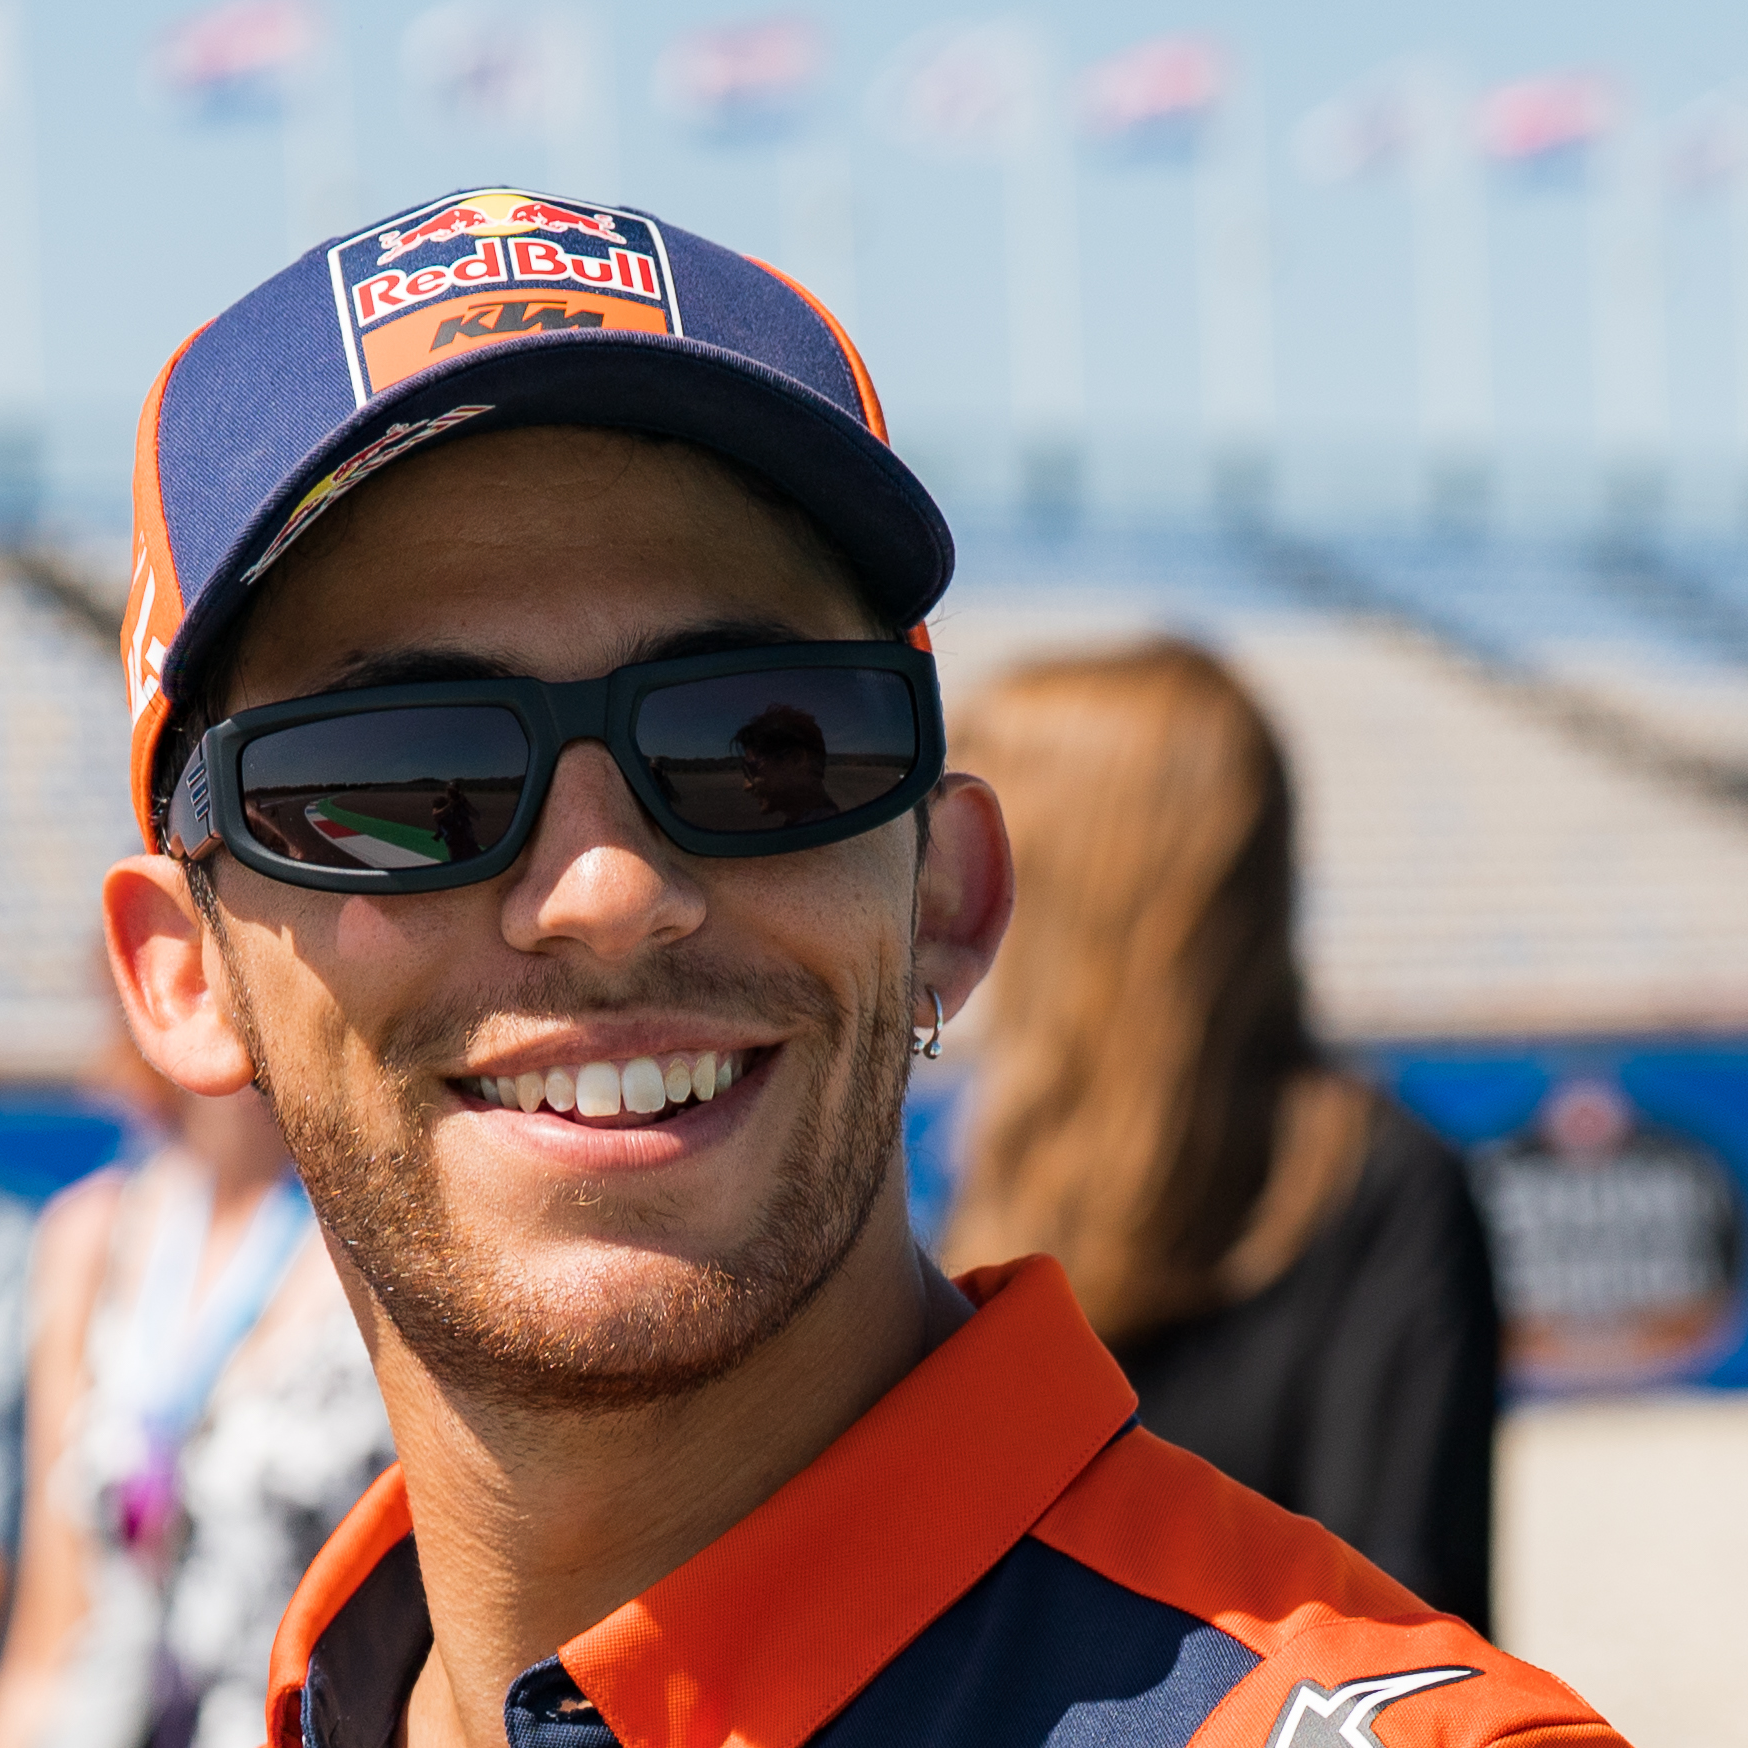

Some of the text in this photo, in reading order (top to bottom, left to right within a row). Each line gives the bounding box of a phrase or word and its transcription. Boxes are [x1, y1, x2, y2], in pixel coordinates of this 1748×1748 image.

[352, 237, 662, 328] Red Bull
[430, 300, 604, 353] KTM
